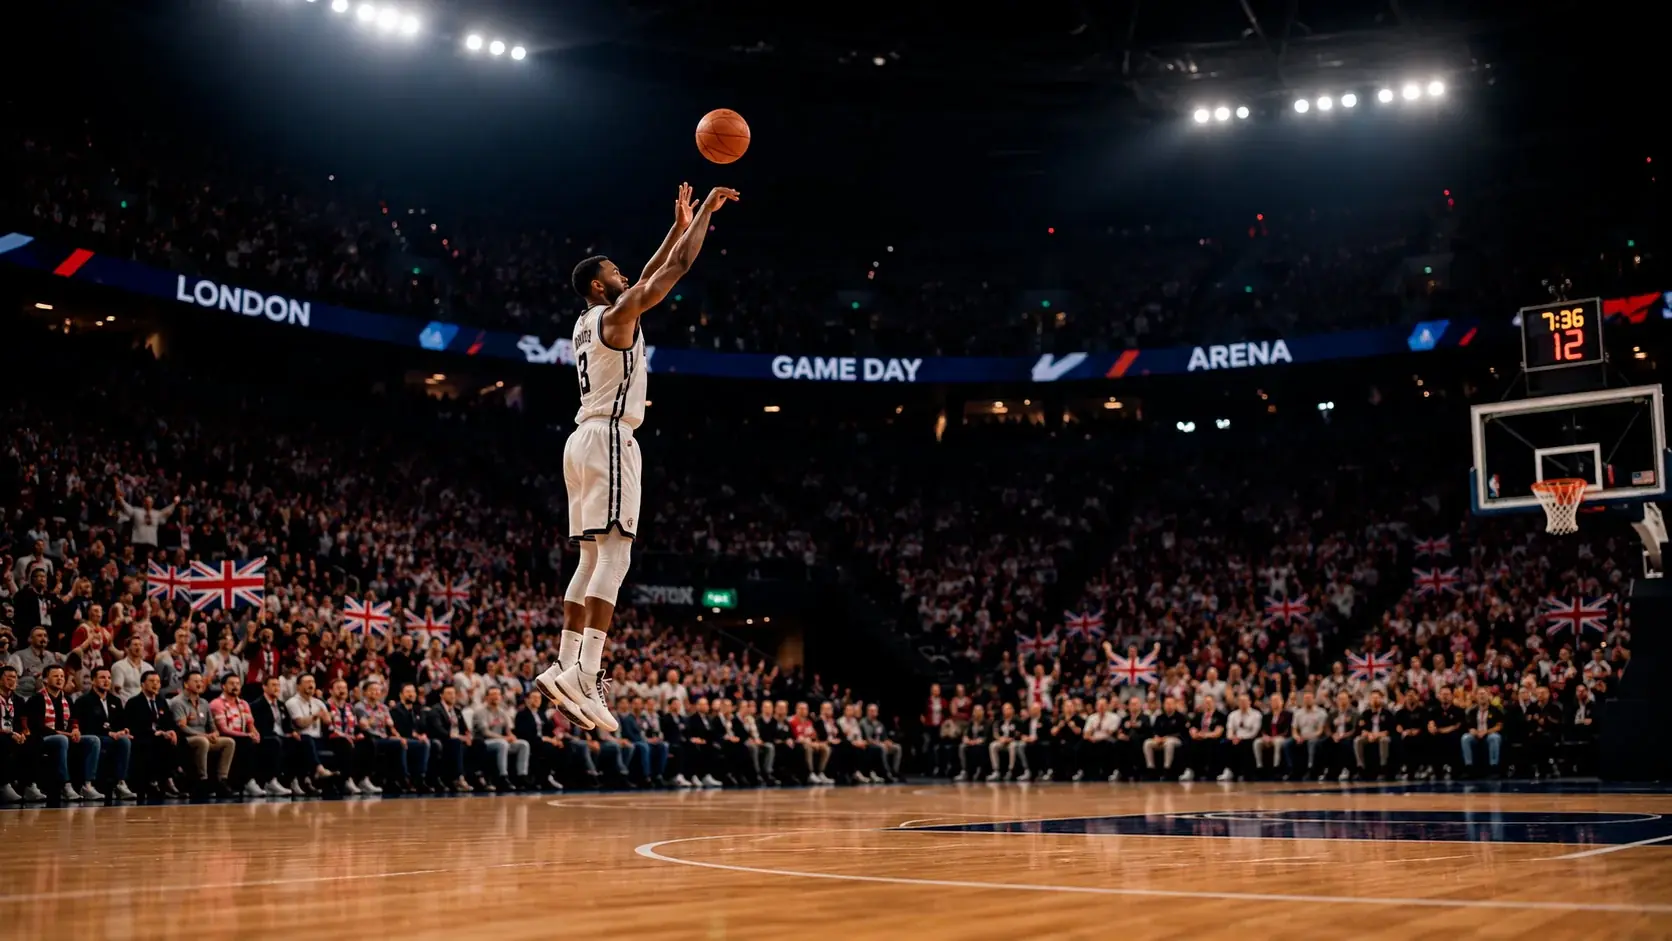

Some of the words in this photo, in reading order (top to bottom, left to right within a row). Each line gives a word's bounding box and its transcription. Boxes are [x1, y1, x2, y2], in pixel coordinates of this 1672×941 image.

[177, 275, 311, 326] LONDON
[1542, 308, 1585, 331] 7:36
[1187, 339, 1292, 371] ARENA
[1553, 329, 1584, 361] 12
[771, 355, 856, 380] GAME
[864, 355, 922, 381] DAY
